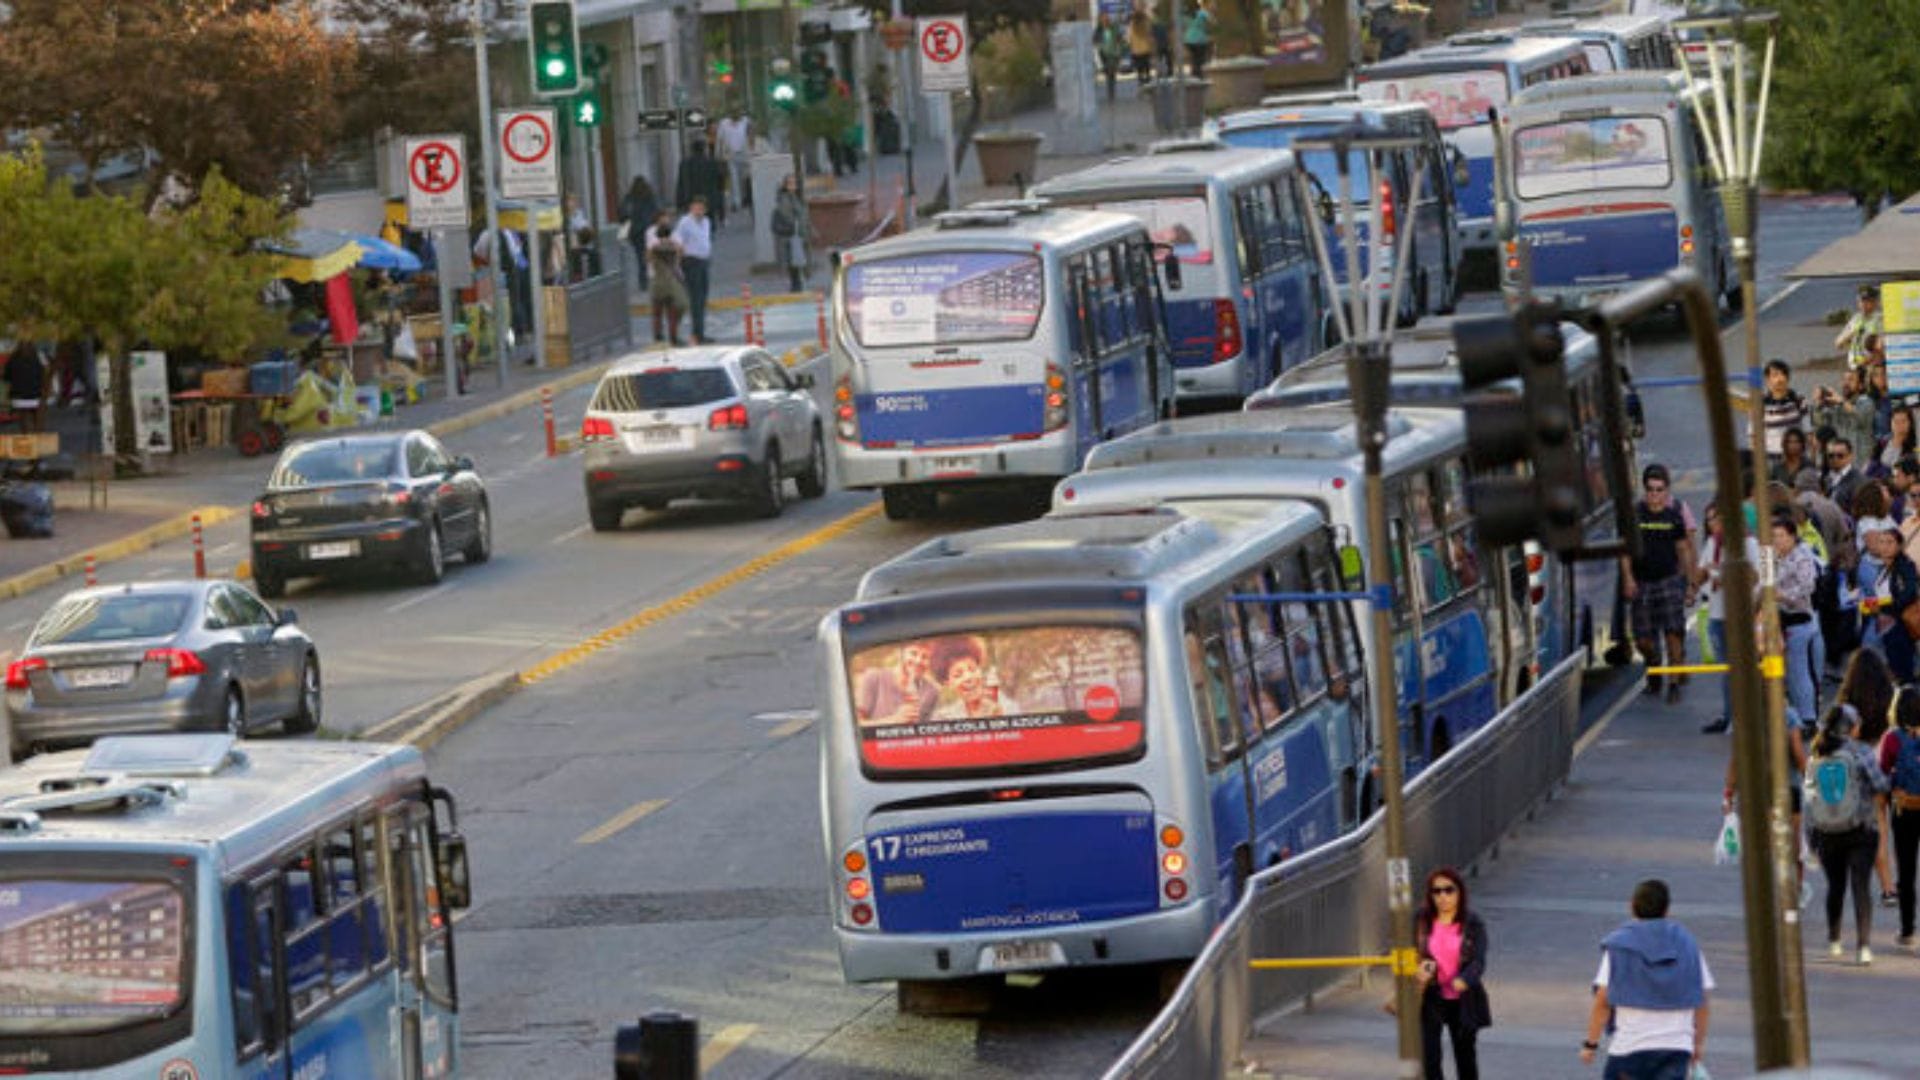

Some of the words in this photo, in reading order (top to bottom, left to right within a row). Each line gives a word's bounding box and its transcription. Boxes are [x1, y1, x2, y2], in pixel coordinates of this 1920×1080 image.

[875, 727, 916, 739] NUEVA
[918, 719, 987, 736] COCA-COLA
[869, 834, 901, 862] 17
[904, 827, 965, 846] EXPRESOS
[961, 914, 1023, 929] MANTENGA
[1024, 909, 1080, 924] DISTANCIA
